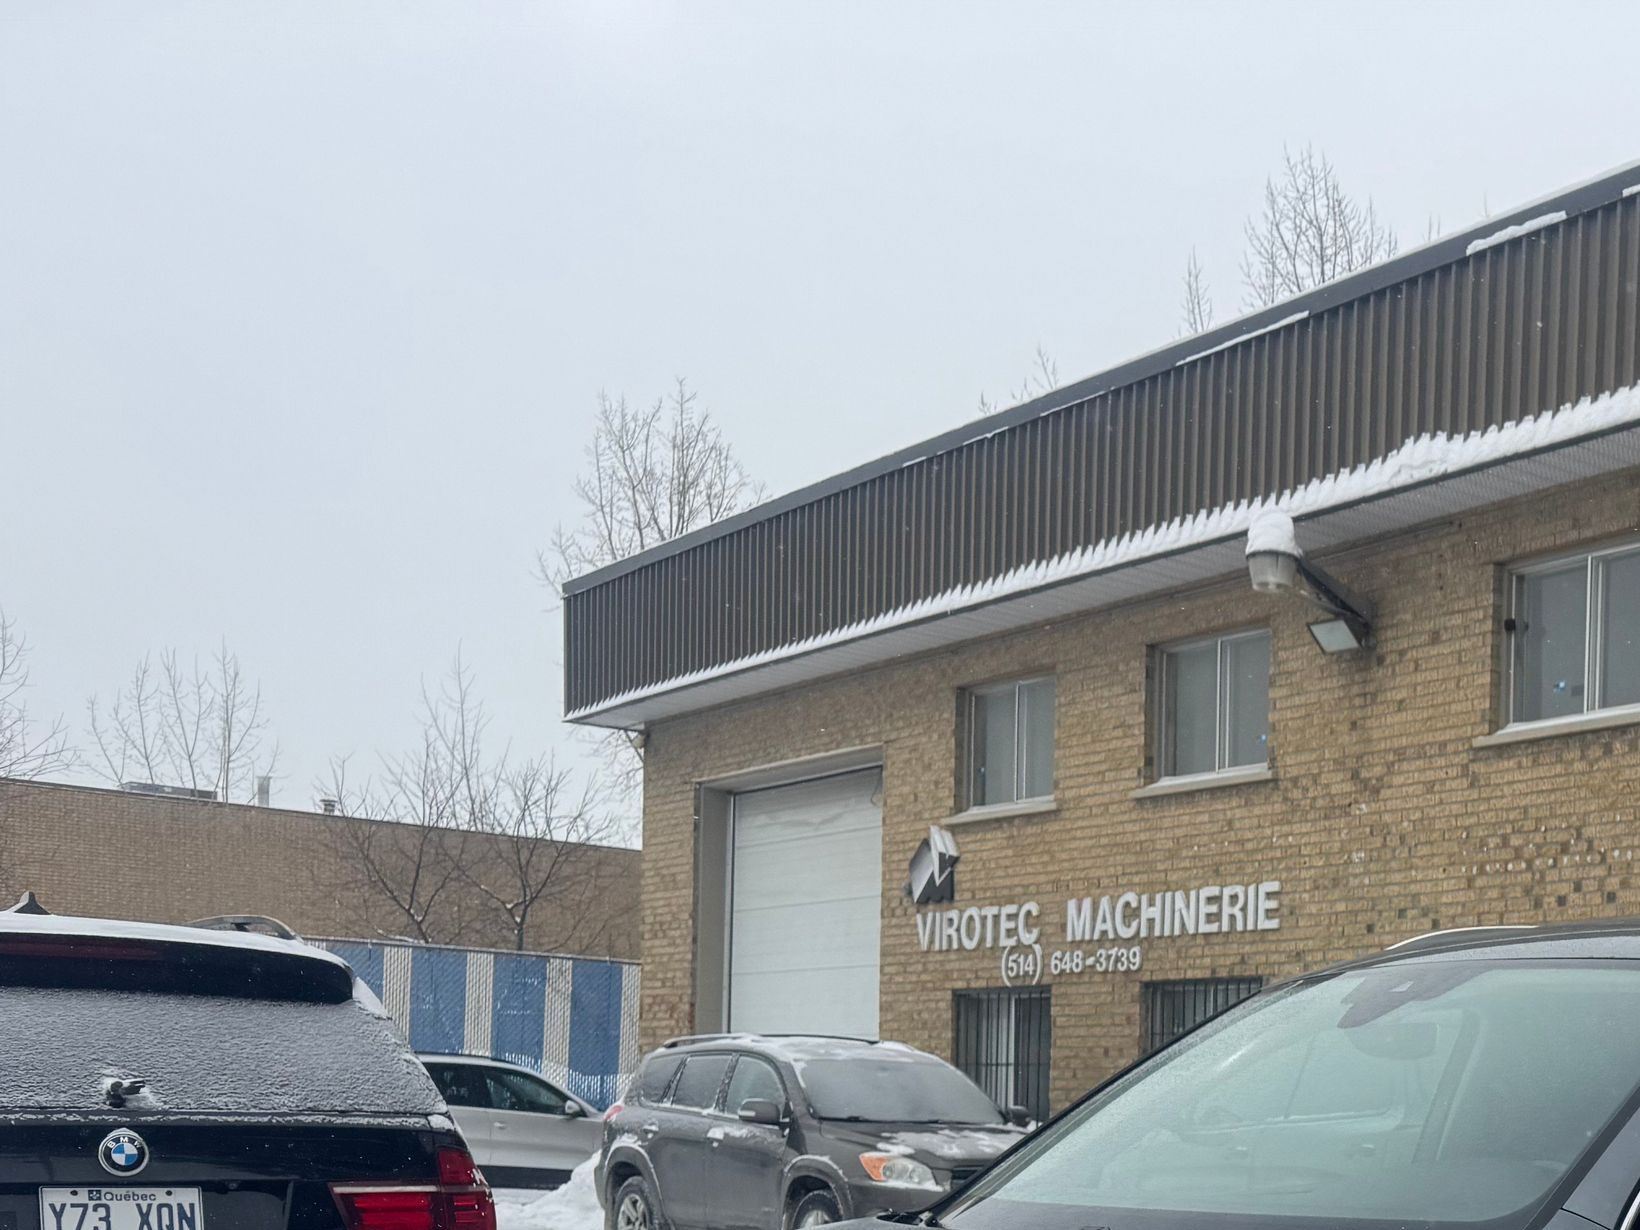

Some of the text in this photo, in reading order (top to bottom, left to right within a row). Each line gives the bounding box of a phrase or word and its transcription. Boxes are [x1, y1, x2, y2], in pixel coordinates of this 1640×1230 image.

[916, 881, 1282, 951] VIROTEC MACHINERIE
[1001, 943, 1141, 988] (514) 648-3739
[104, 1191, 156, 1201] Québec
